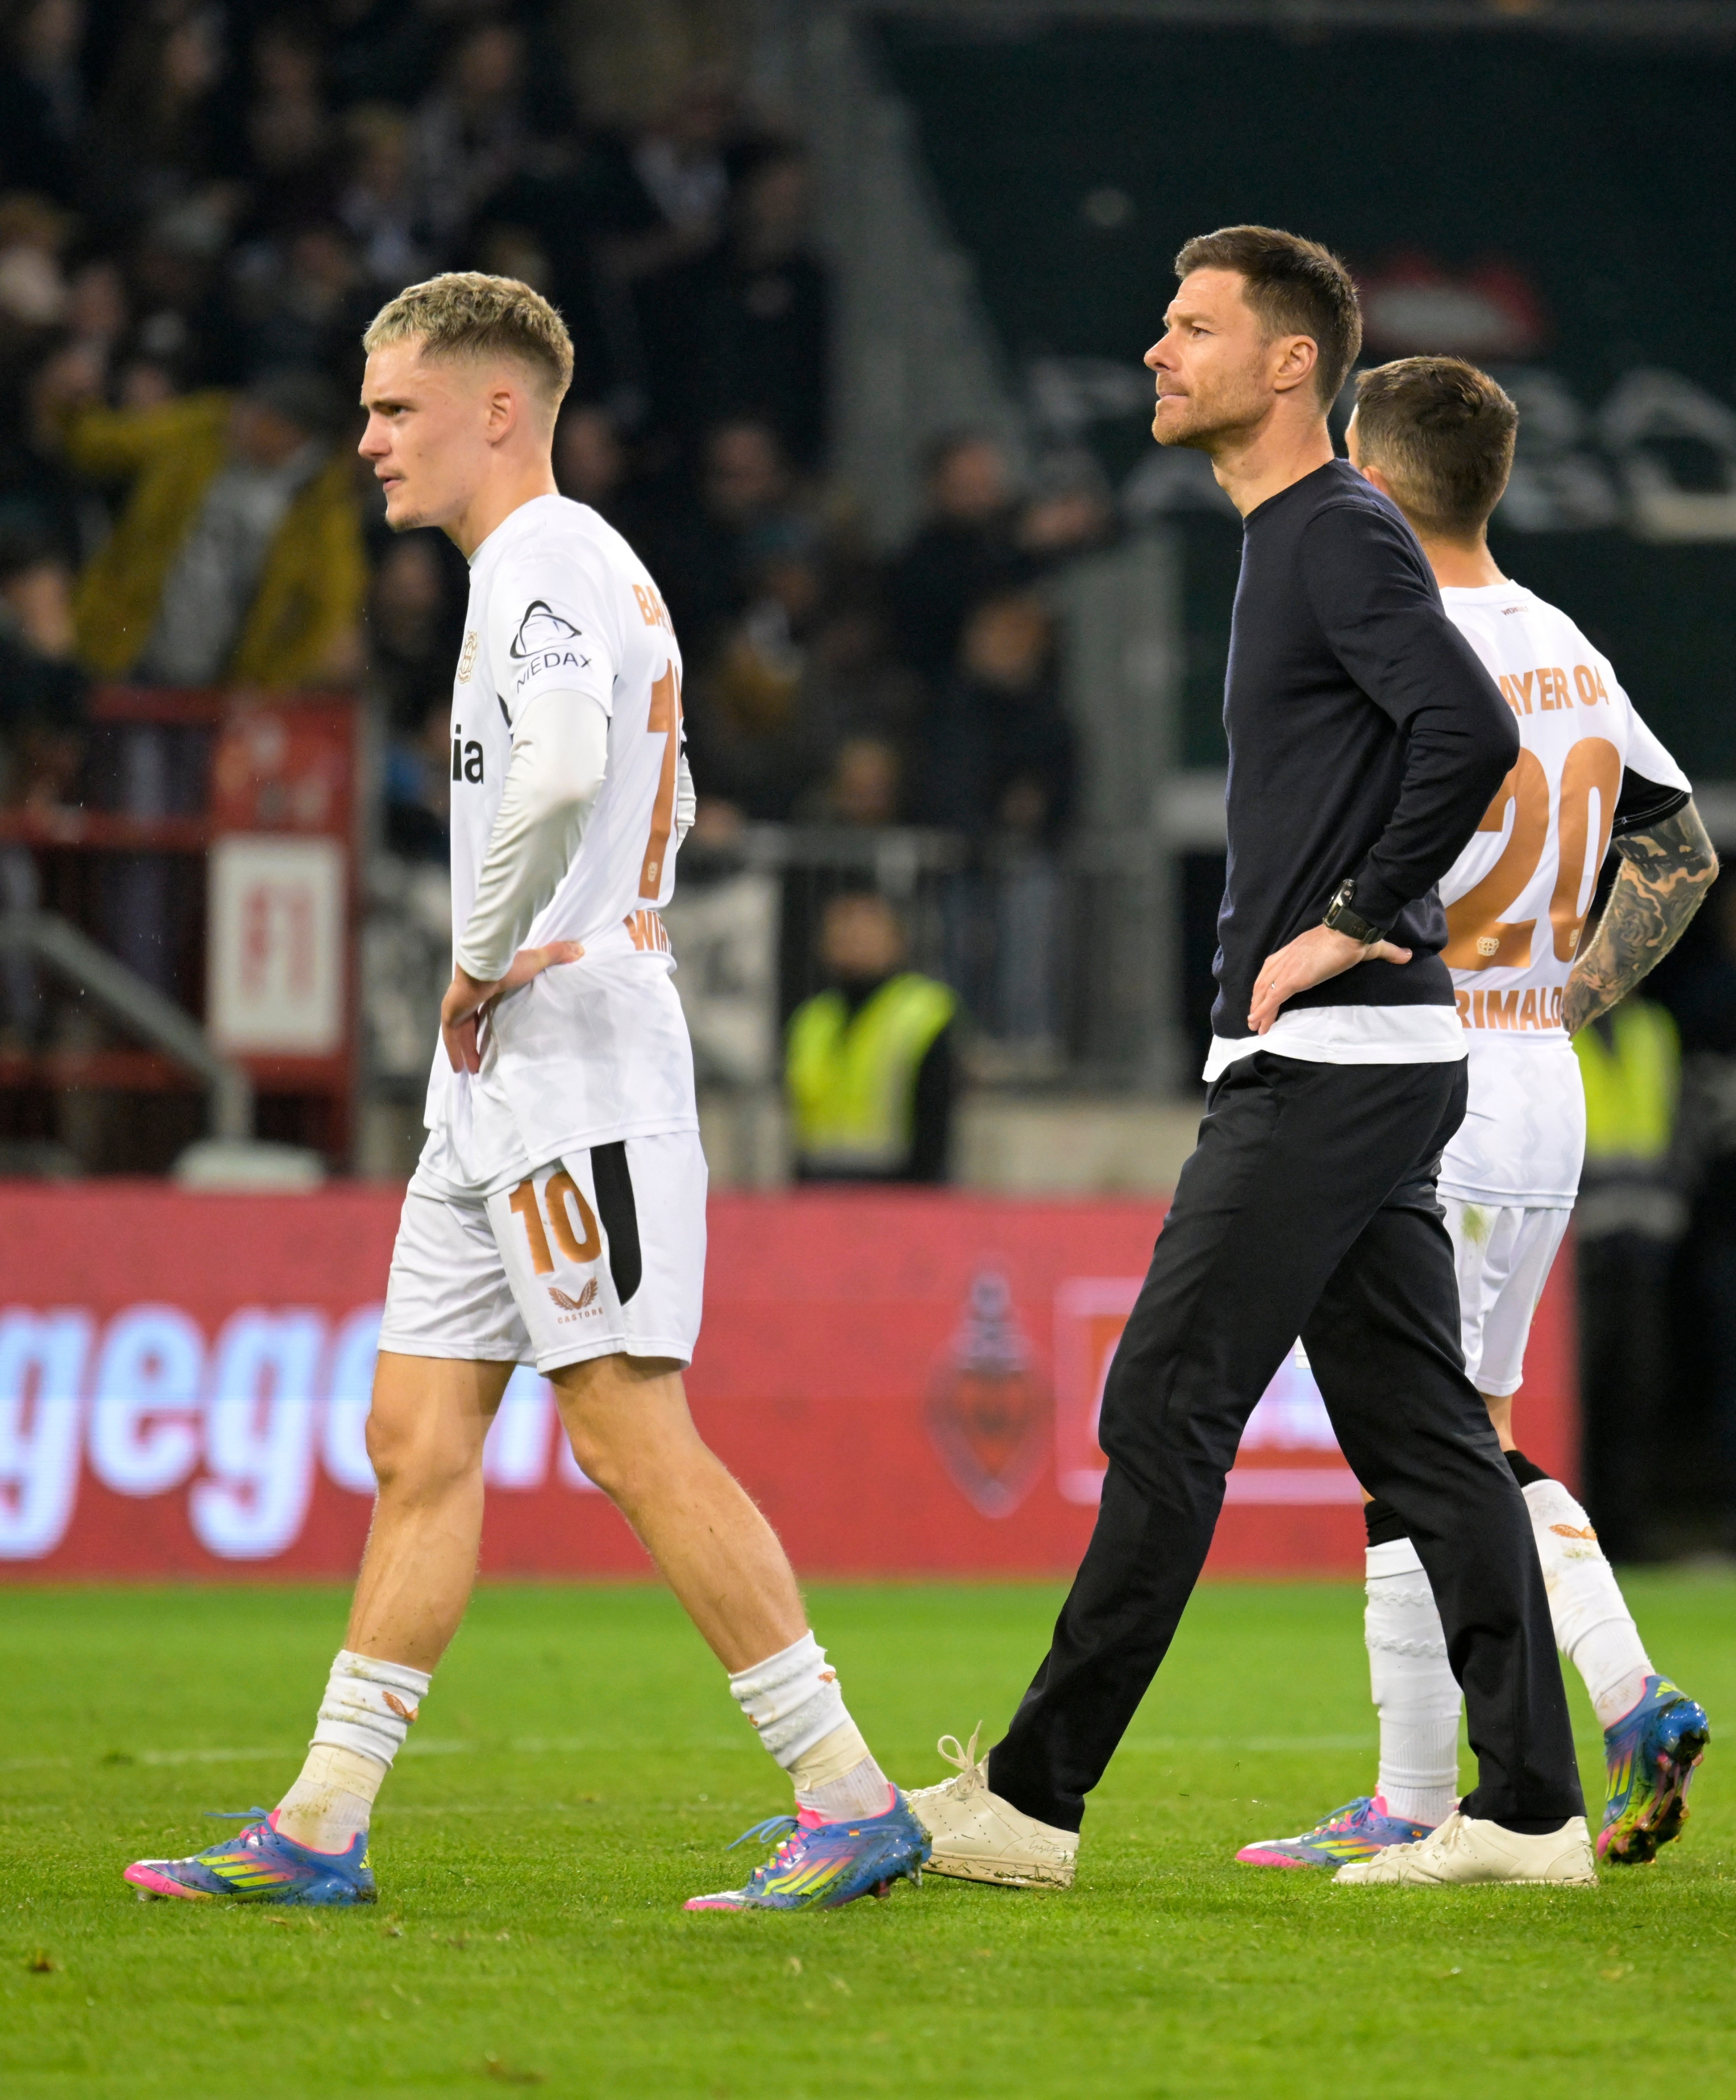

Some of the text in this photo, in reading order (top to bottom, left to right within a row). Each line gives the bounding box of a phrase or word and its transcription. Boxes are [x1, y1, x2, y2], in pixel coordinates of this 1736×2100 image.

[517, 652, 593, 694] NIEDAX
[1573, 664, 1610, 706] 04
[452, 723, 484, 785] ia
[1441, 737, 1621, 971] 20
[508, 1171, 602, 1275] 10
[557, 1307, 604, 1324] CASTORE
